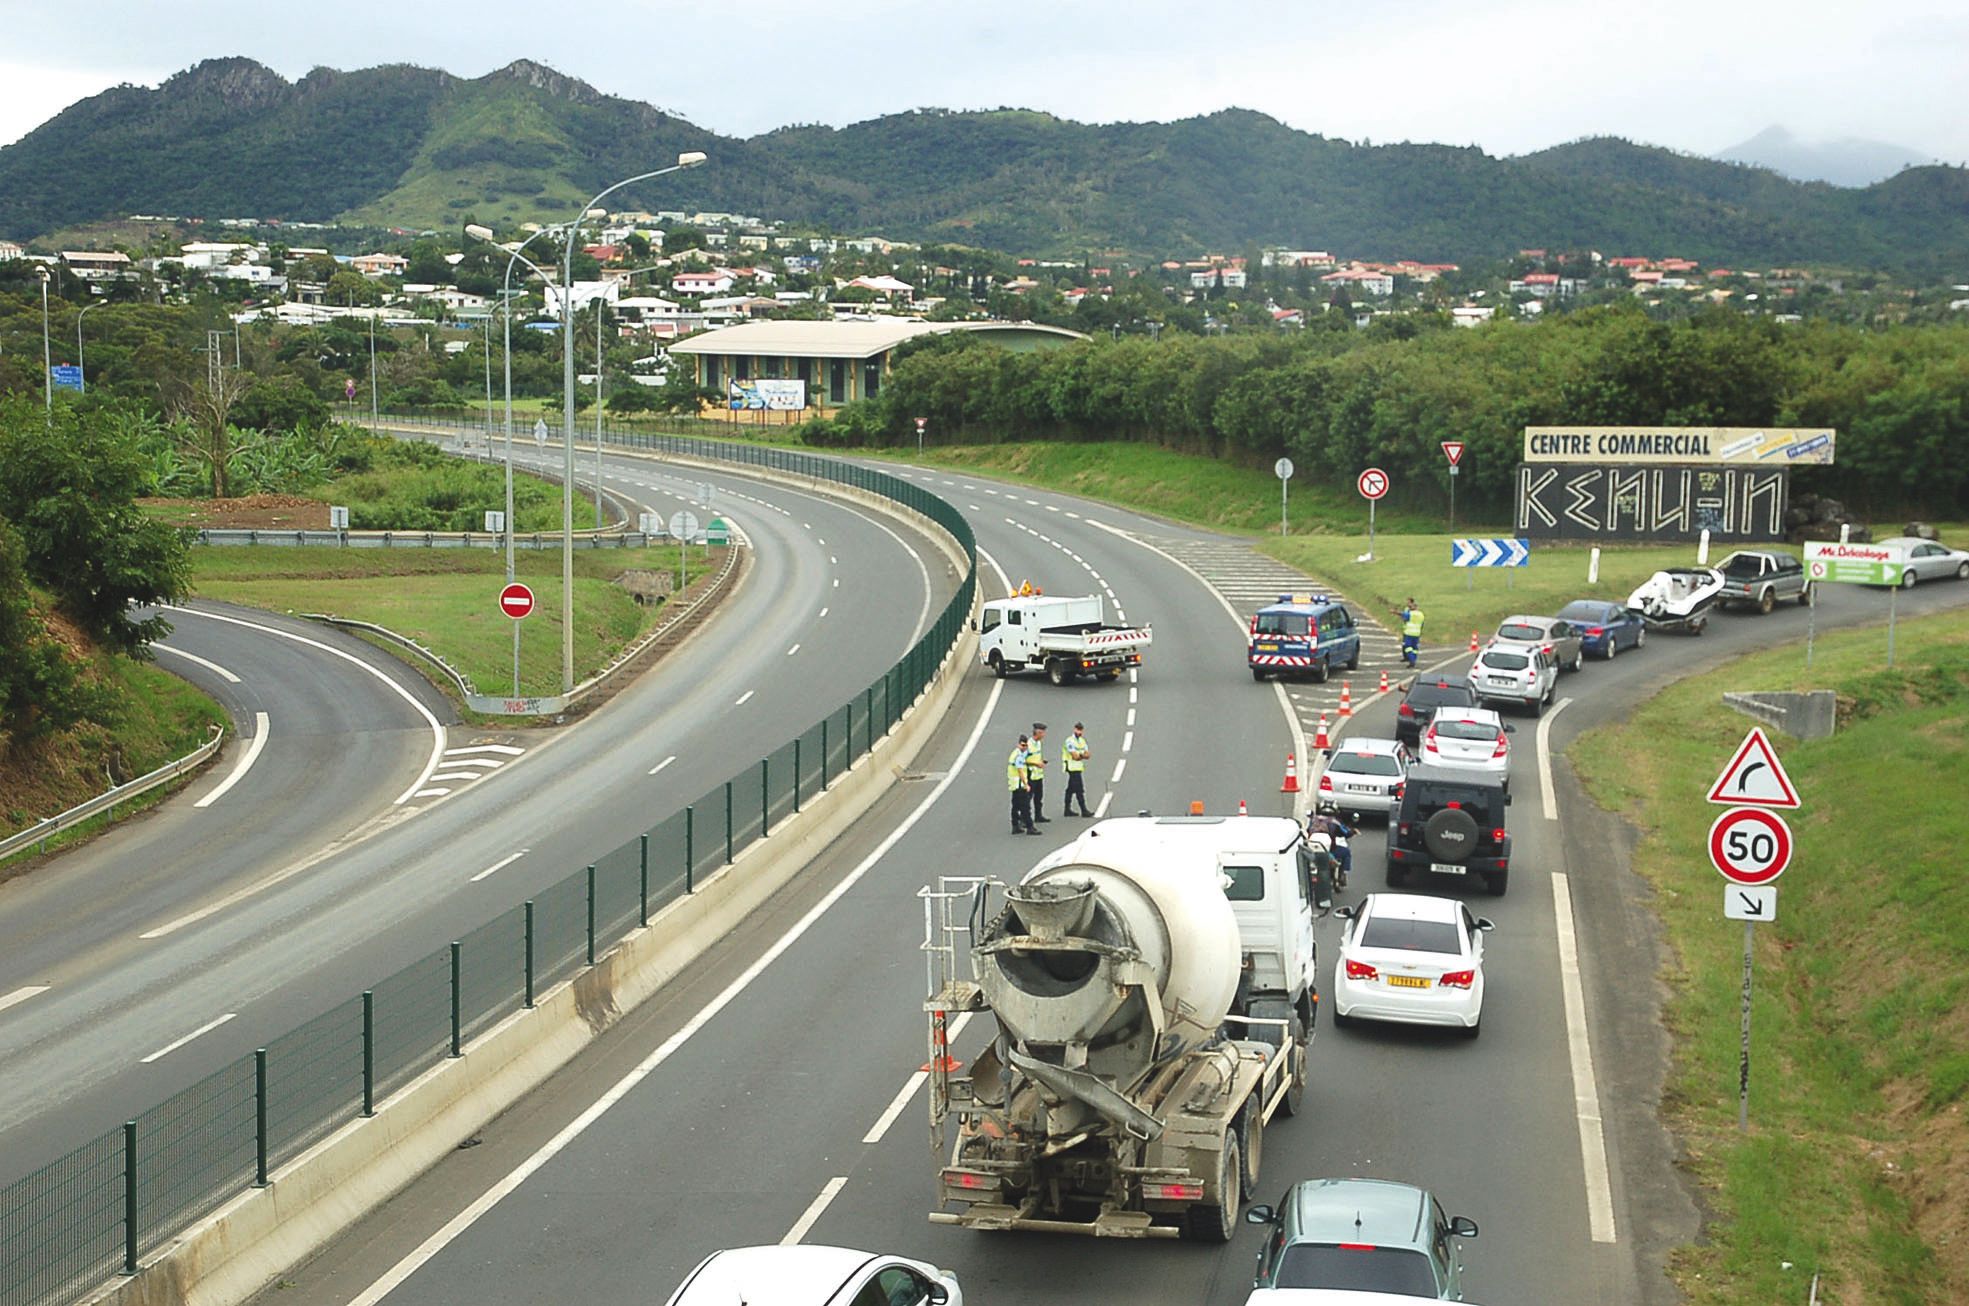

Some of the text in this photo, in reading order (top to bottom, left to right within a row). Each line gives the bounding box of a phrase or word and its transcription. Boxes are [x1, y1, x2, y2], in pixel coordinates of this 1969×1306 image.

[1531, 434, 1591, 454] CENTRE
[1598, 434, 1711, 455] COMMERCIAL
[1440, 830, 1465, 841] Jeep
[1727, 831, 1774, 863] 50
